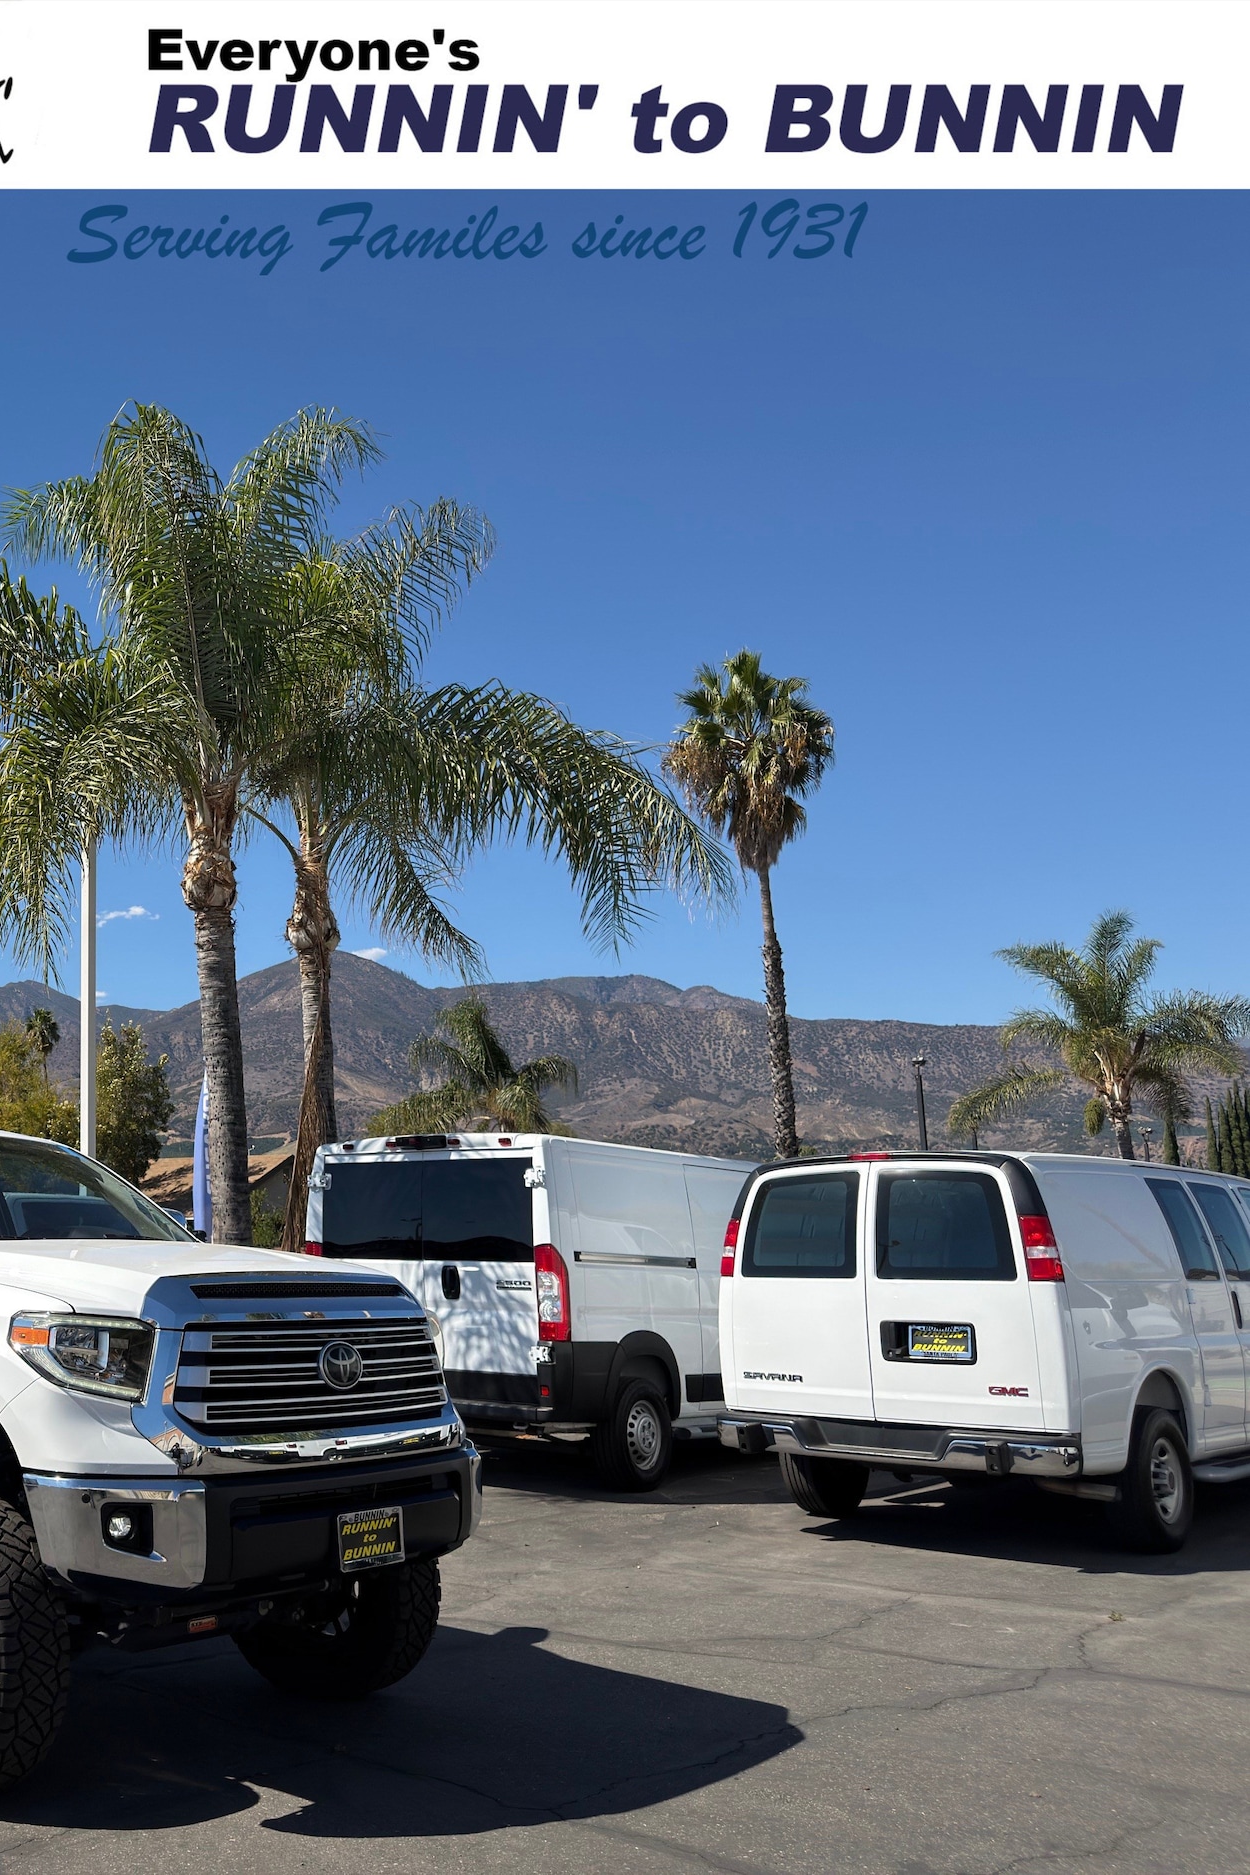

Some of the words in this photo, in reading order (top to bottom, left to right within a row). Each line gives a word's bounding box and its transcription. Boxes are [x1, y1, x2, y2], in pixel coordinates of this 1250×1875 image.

[914, 1331, 967, 1339] RUNNIN'
[912, 1343, 965, 1352] BUNNIN
[743, 1371, 803, 1383] SAVANA
[988, 1386, 1029, 1397] GMC
[354, 1509, 385, 1521] BUNNIN
[341, 1517, 397, 1536] RUNNIN'
[363, 1533, 378, 1543] to
[343, 1541, 396, 1561] BUNNIN
